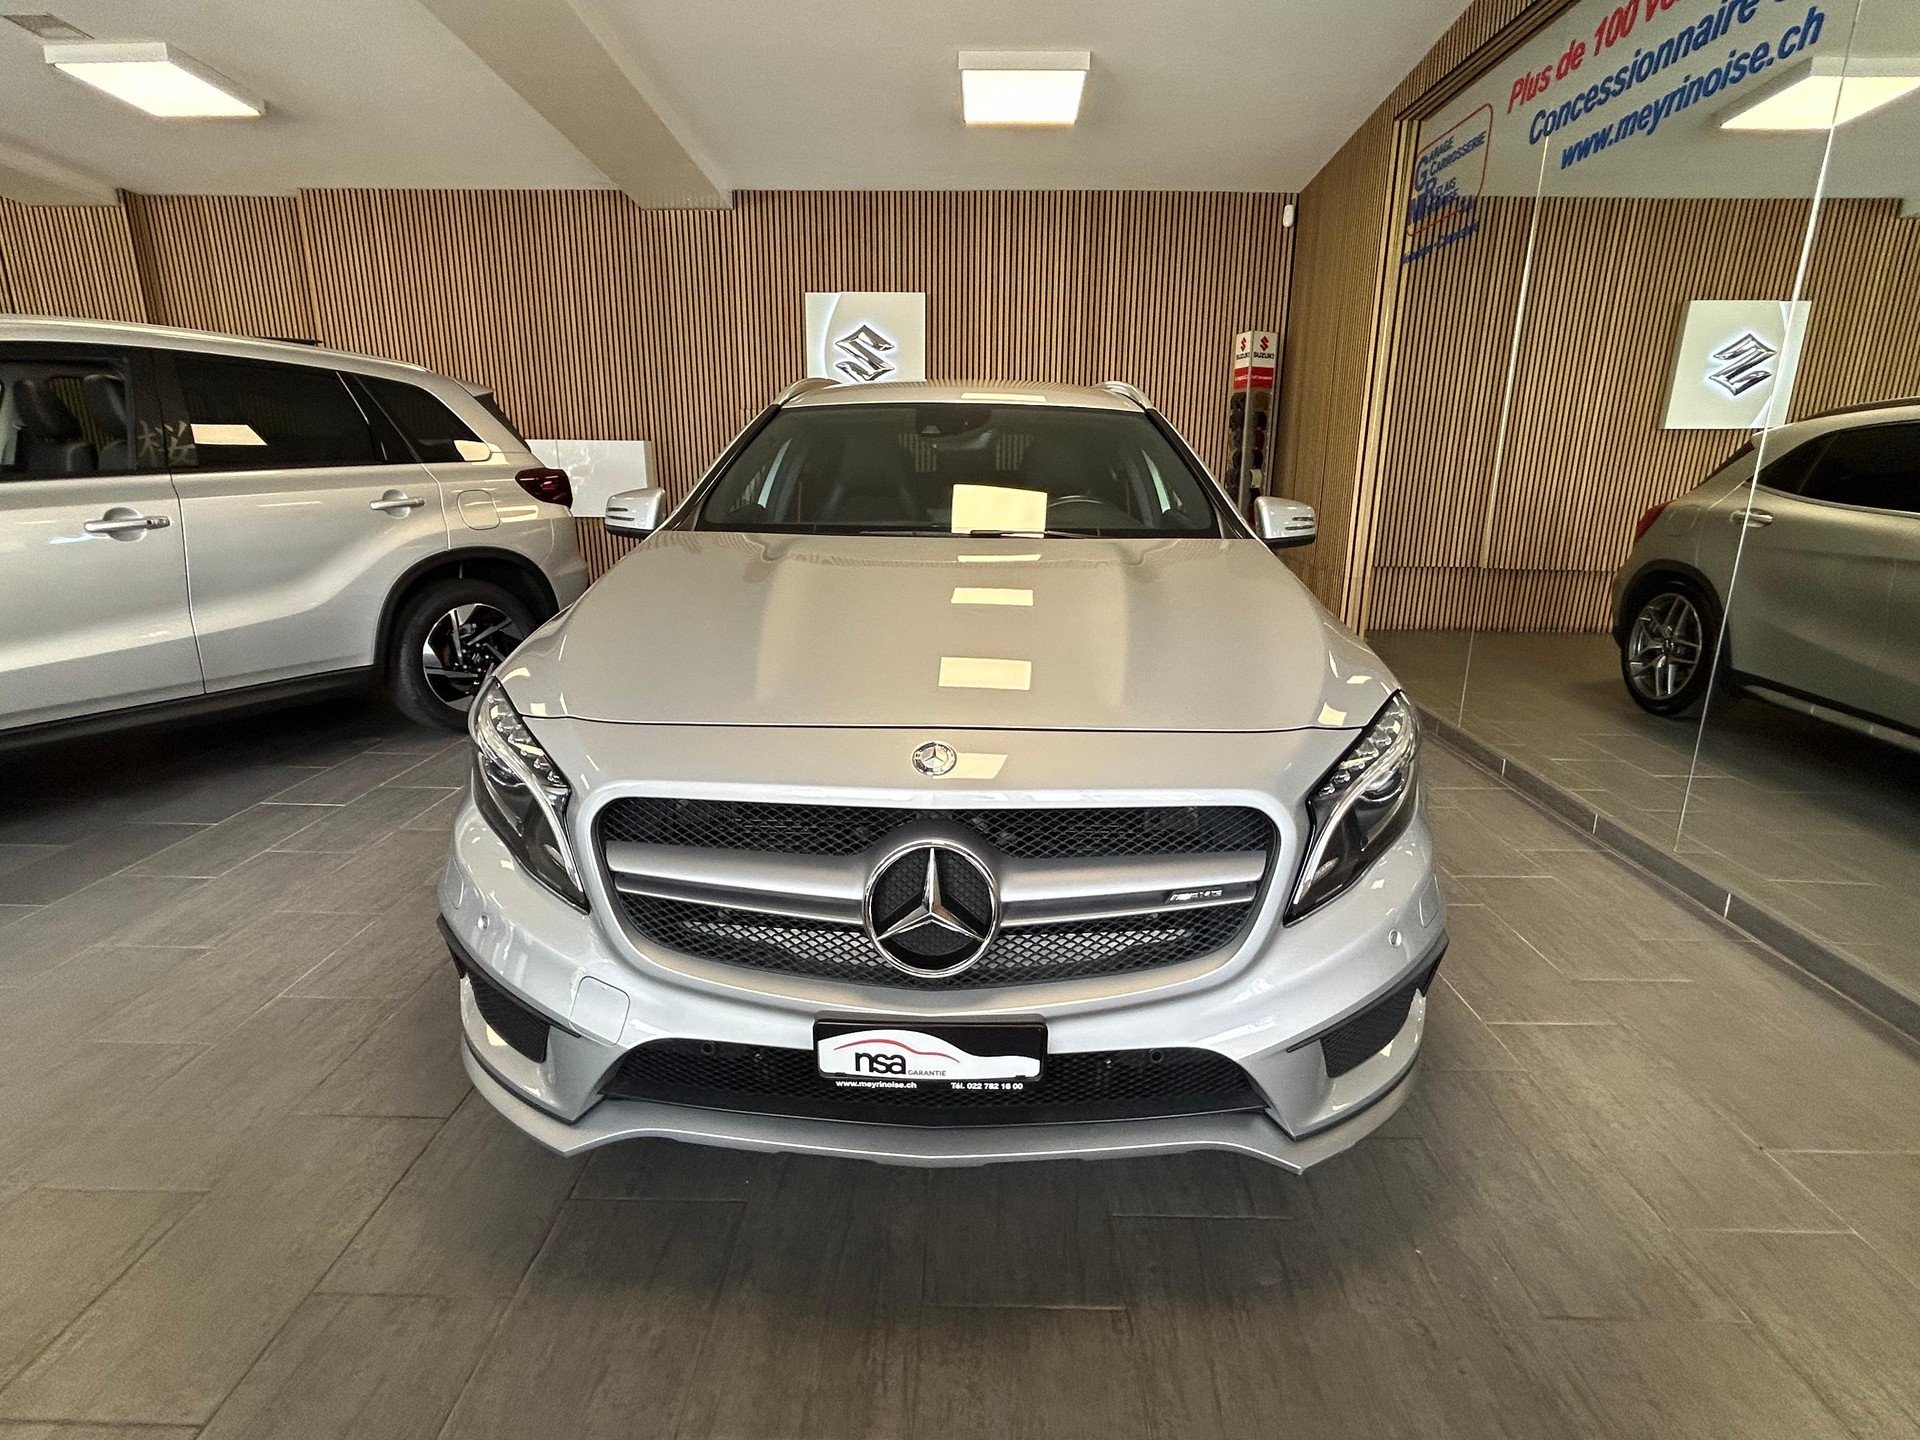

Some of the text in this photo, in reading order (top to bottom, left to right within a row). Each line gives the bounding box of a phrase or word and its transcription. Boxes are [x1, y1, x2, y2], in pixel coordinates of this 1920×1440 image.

[1507, 65, 1552, 114] Plus
[1556, 39, 1586, 80] de
[1593, 0, 1639, 56] 100
[1528, 0, 1763, 145] Concessionnaire
[1560, 6, 1826, 169] www.meyrinoise.ch
[1253, 351, 1274, 359] SUZUKI
[855, 1052, 906, 1074] nsa
[908, 1069, 946, 1077] GARANTIE
[835, 1080, 918, 1089] www.meyrinoise.ch
[966, 1082, 982, 1090] 022
[1012, 1082, 1024, 1090] 00
